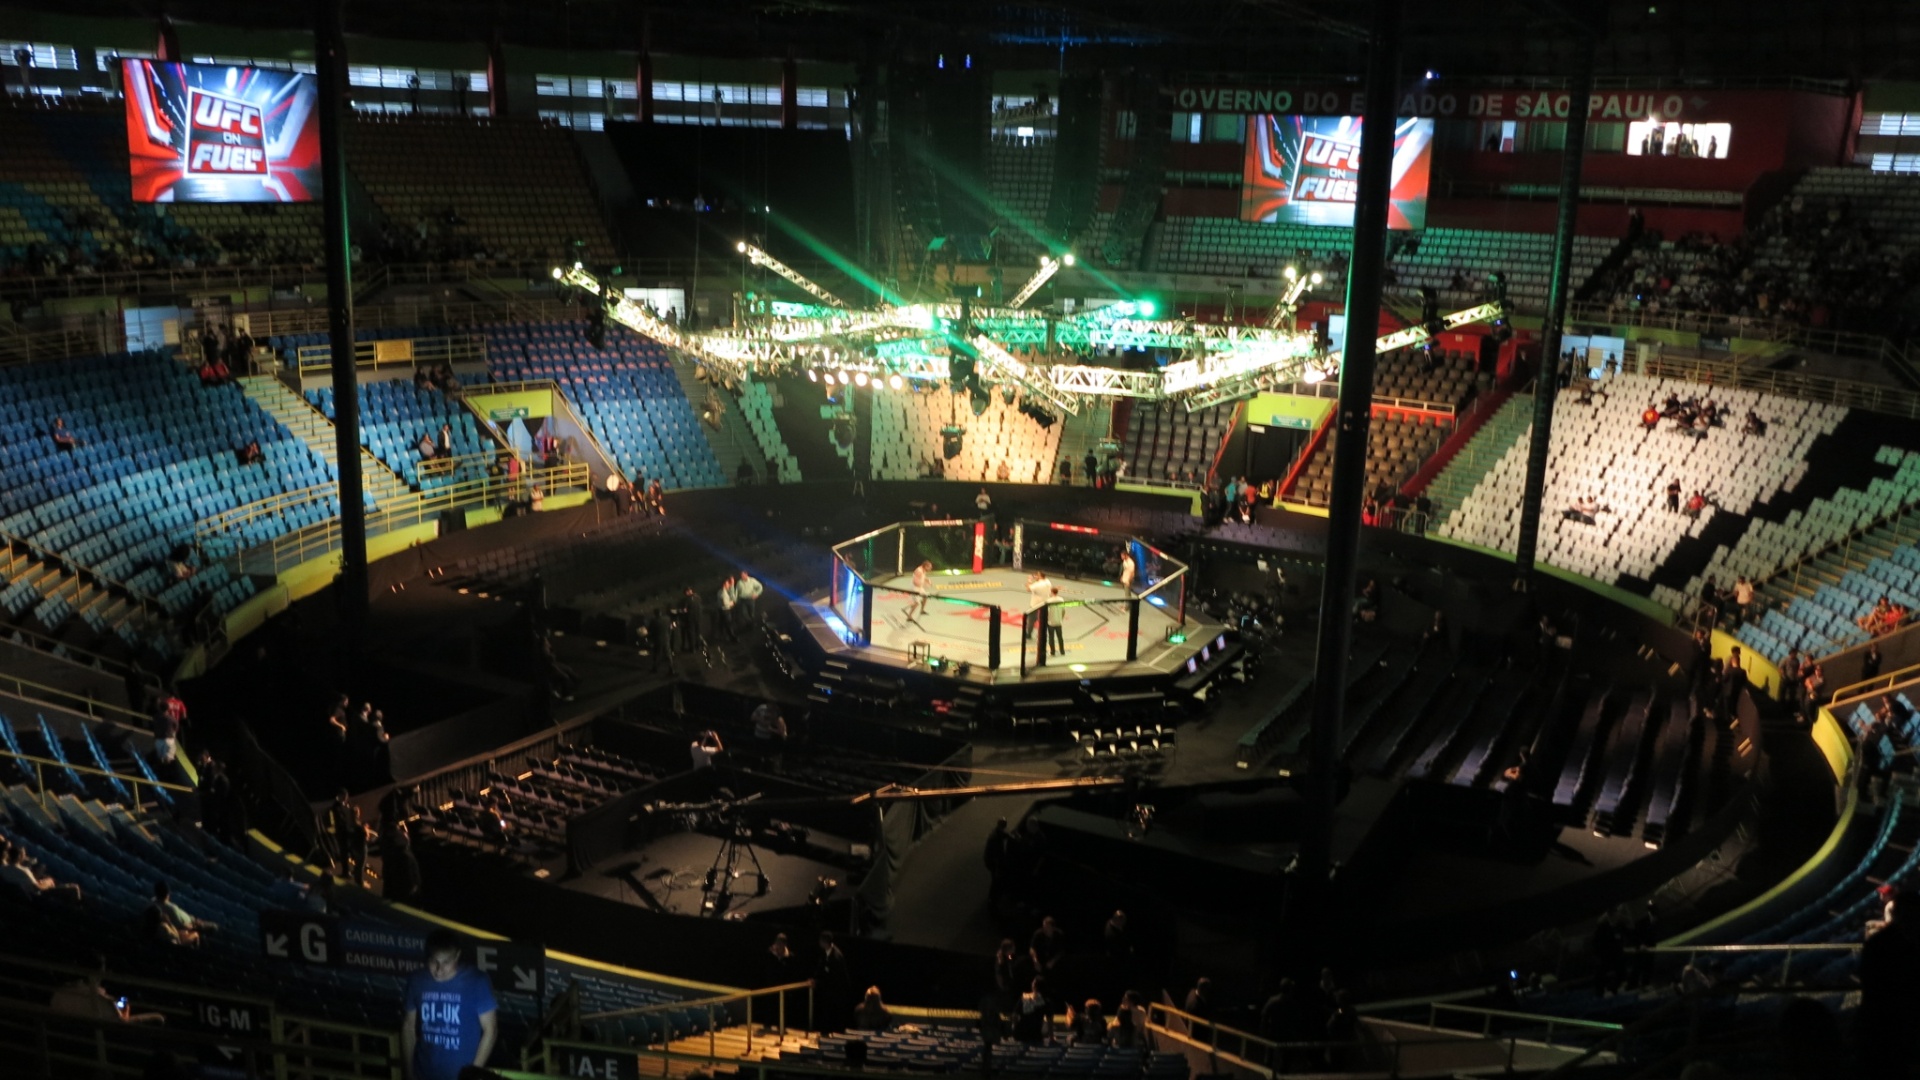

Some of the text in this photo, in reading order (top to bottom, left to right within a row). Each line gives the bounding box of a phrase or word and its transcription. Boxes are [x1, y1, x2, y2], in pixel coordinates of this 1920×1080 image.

[195, 95, 260, 134] UFC
[1173, 88, 1684, 119] OVERNO DO EADO DE SÃO PAULO
[223, 132, 242, 146] ON
[1329, 168, 1346, 179] ON
[301, 922, 328, 963] G
[345, 927, 396, 947] CADEIRA
[345, 951, 396, 971] CADEIRA
[421, 1001, 461, 1026] CI-UK
